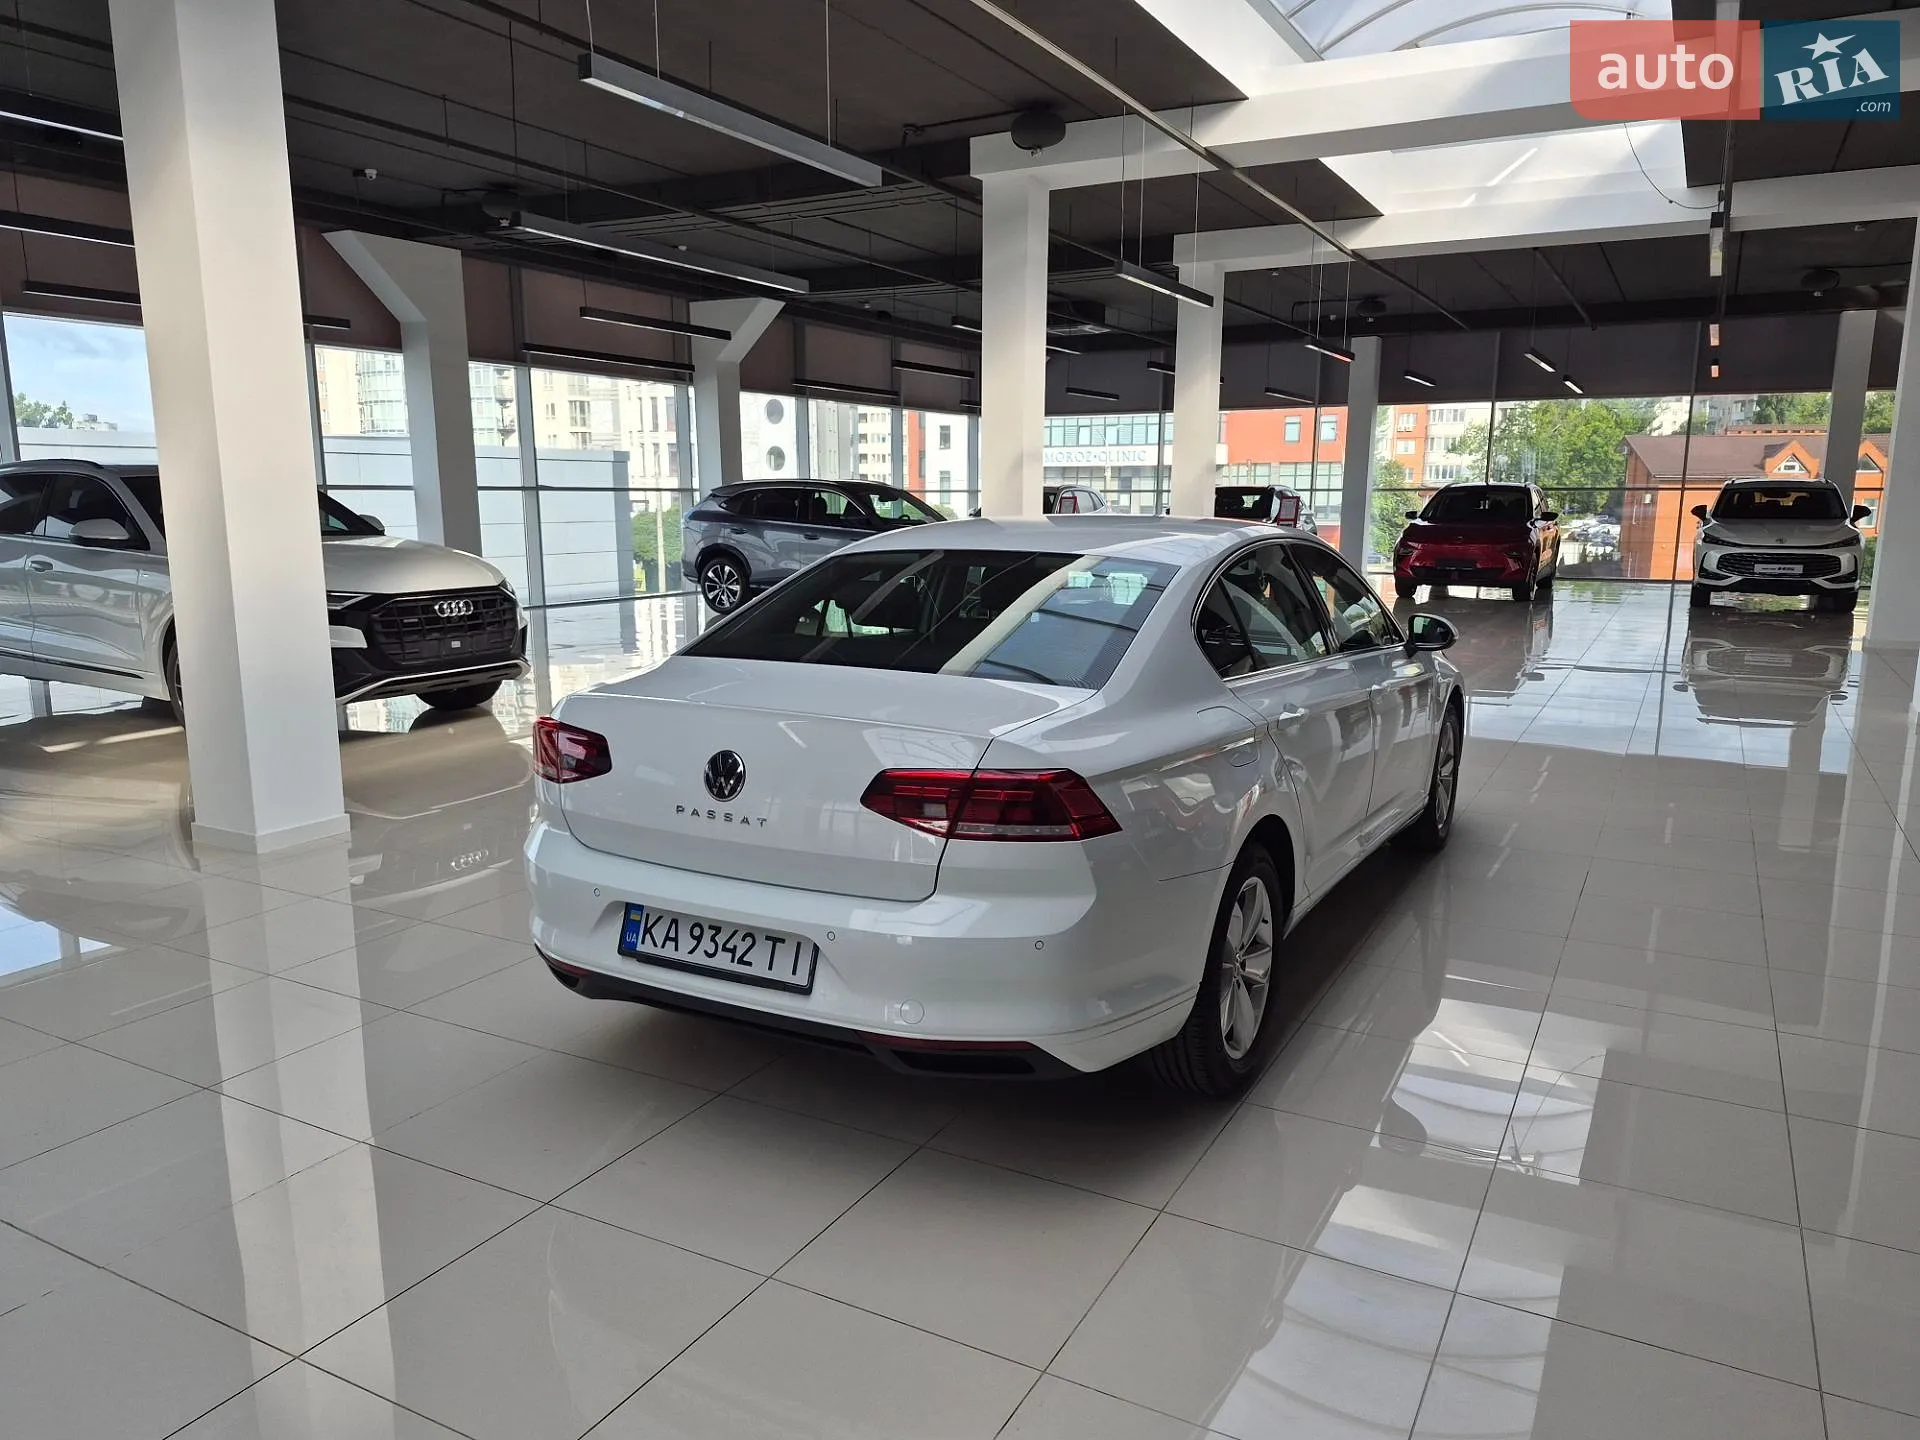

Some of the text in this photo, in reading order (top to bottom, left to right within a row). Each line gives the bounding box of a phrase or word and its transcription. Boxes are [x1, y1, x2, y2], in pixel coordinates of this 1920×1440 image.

[675, 804, 768, 828] PASSAT
[626, 931, 638, 944] UA
[641, 912, 680, 952] KA
[687, 921, 757, 967] 9342
